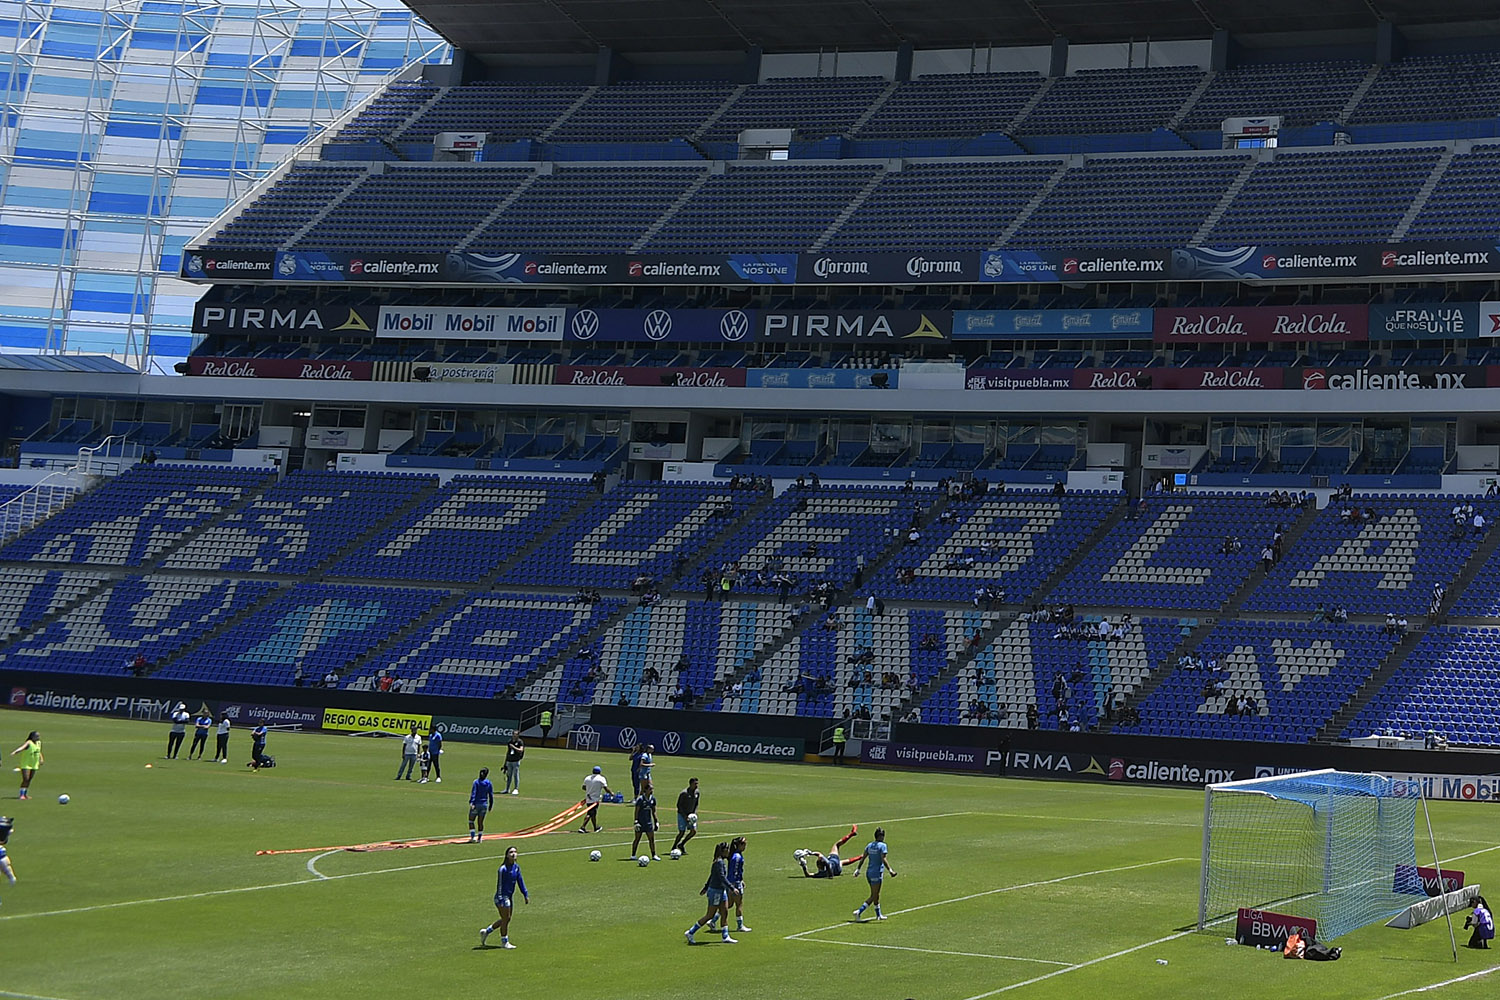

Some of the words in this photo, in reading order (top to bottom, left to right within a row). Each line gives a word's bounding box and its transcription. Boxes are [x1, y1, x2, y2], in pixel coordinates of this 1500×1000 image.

[216, 259, 271, 271] caliente.mx
[1078, 258, 1164, 273] caliente.mx
[1277, 254, 1357, 270] caliente.mx
[1400, 250, 1489, 267] caliente.mx
[364, 260, 439, 274] caliente.mx
[537, 262, 608, 277] caliente.mx
[643, 262, 721, 276] caliente.mx
[742, 266, 764, 275] NOS
[766, 266, 788, 275] UNE
[813, 257, 869, 279] Corona
[906, 256, 962, 279] Corona
[202, 307, 324, 329] PIRMA
[383, 313, 433, 331] Mobil
[445, 313, 495, 332] Mobil
[507, 315, 557, 333] Mobil
[764, 314, 894, 337] PIRMA
[988, 377, 1070, 390] visitpuebla.mx
[26, 691, 114, 711] caliente.mx
[248, 707, 317, 723] visitpuebla.mx
[324, 713, 356, 726] REGIO
[358, 715, 379, 728] GAS
[381, 717, 429, 731] CENTRAL
[449, 723, 479, 735] Banco
[479, 725, 515, 737] Azteca
[714, 740, 751, 754] Banco
[752, 742, 796, 756] Azteca
[896, 747, 974, 763] visitpuebla.mx
[986, 750, 1072, 772] PIRMA
[1126, 760, 1236, 784] caliente.mx
[1243, 909, 1264, 921] LIGA
[1252, 922, 1289, 939] BBVA
